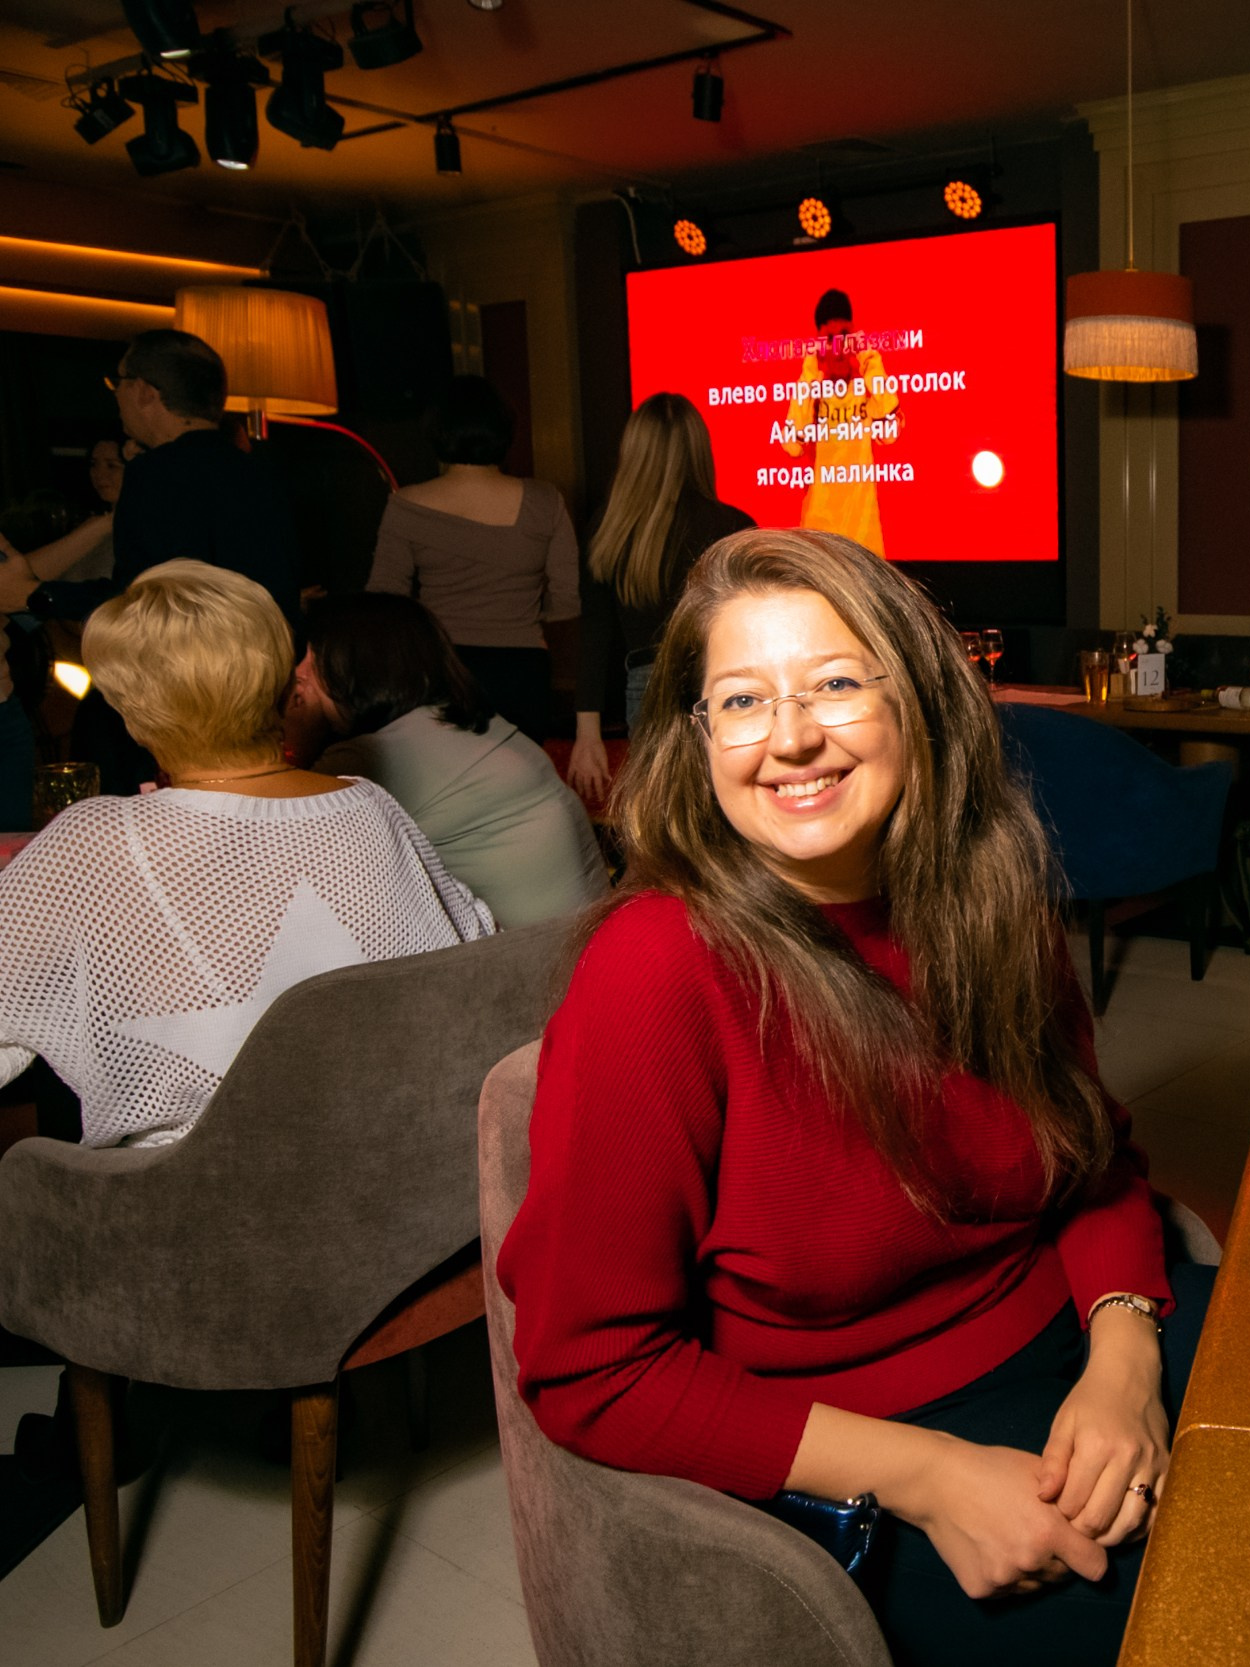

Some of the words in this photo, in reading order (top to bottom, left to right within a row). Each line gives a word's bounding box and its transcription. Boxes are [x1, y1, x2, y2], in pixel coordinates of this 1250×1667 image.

[833, 329, 923, 356] глазами
[708, 385, 767, 406] влево
[773, 377, 848, 405] вправо
[853, 377, 866, 396] в
[872, 371, 966, 394] потолок
[770, 414, 898, 444] Ай-яй-яй-яй
[757, 466, 815, 488] ягода
[821, 463, 915, 483] малинка
[1143, 670, 1159, 686] 12
